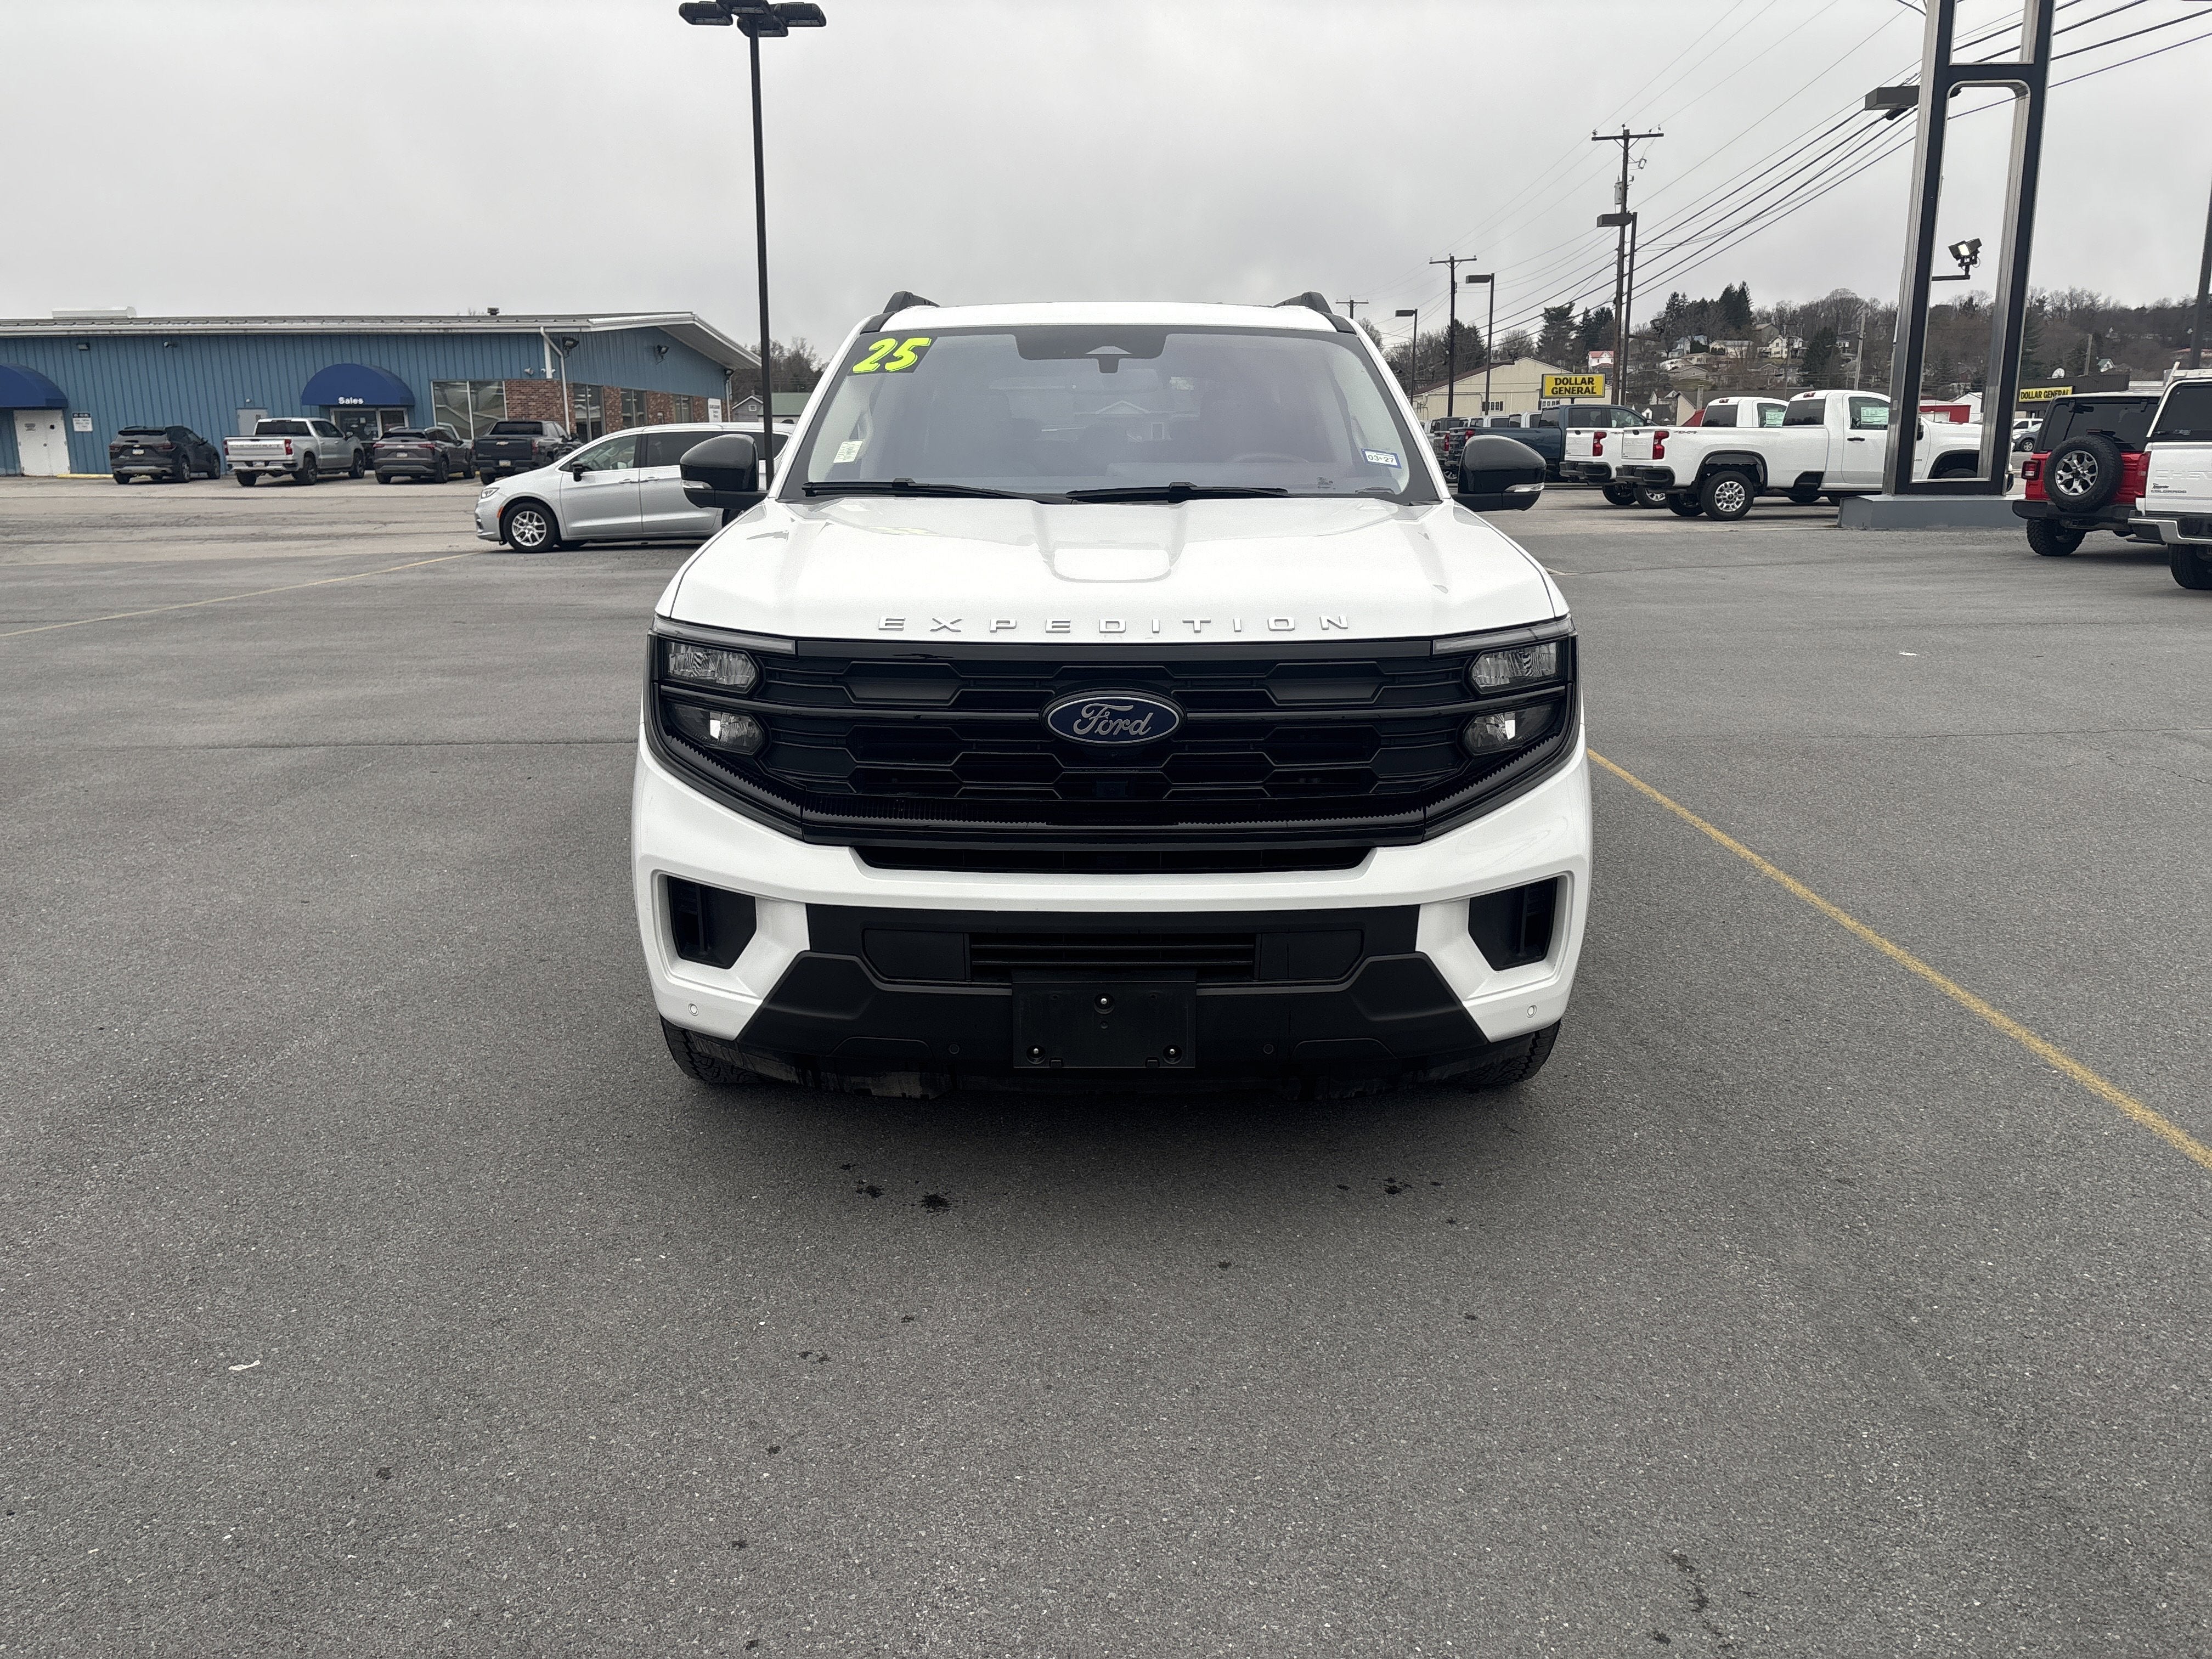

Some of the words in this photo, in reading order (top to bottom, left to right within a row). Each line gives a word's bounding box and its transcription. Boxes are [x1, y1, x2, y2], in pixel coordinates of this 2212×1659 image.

[853, 337, 932, 374] 25
[1554, 377, 1595, 386] DOLLAR
[1551, 386, 1596, 395] GENERAL
[2021, 391, 2042, 399] DOLLAR
[878, 616, 1348, 633] EXPEDITION
[1073, 703, 1154, 736] Ford
